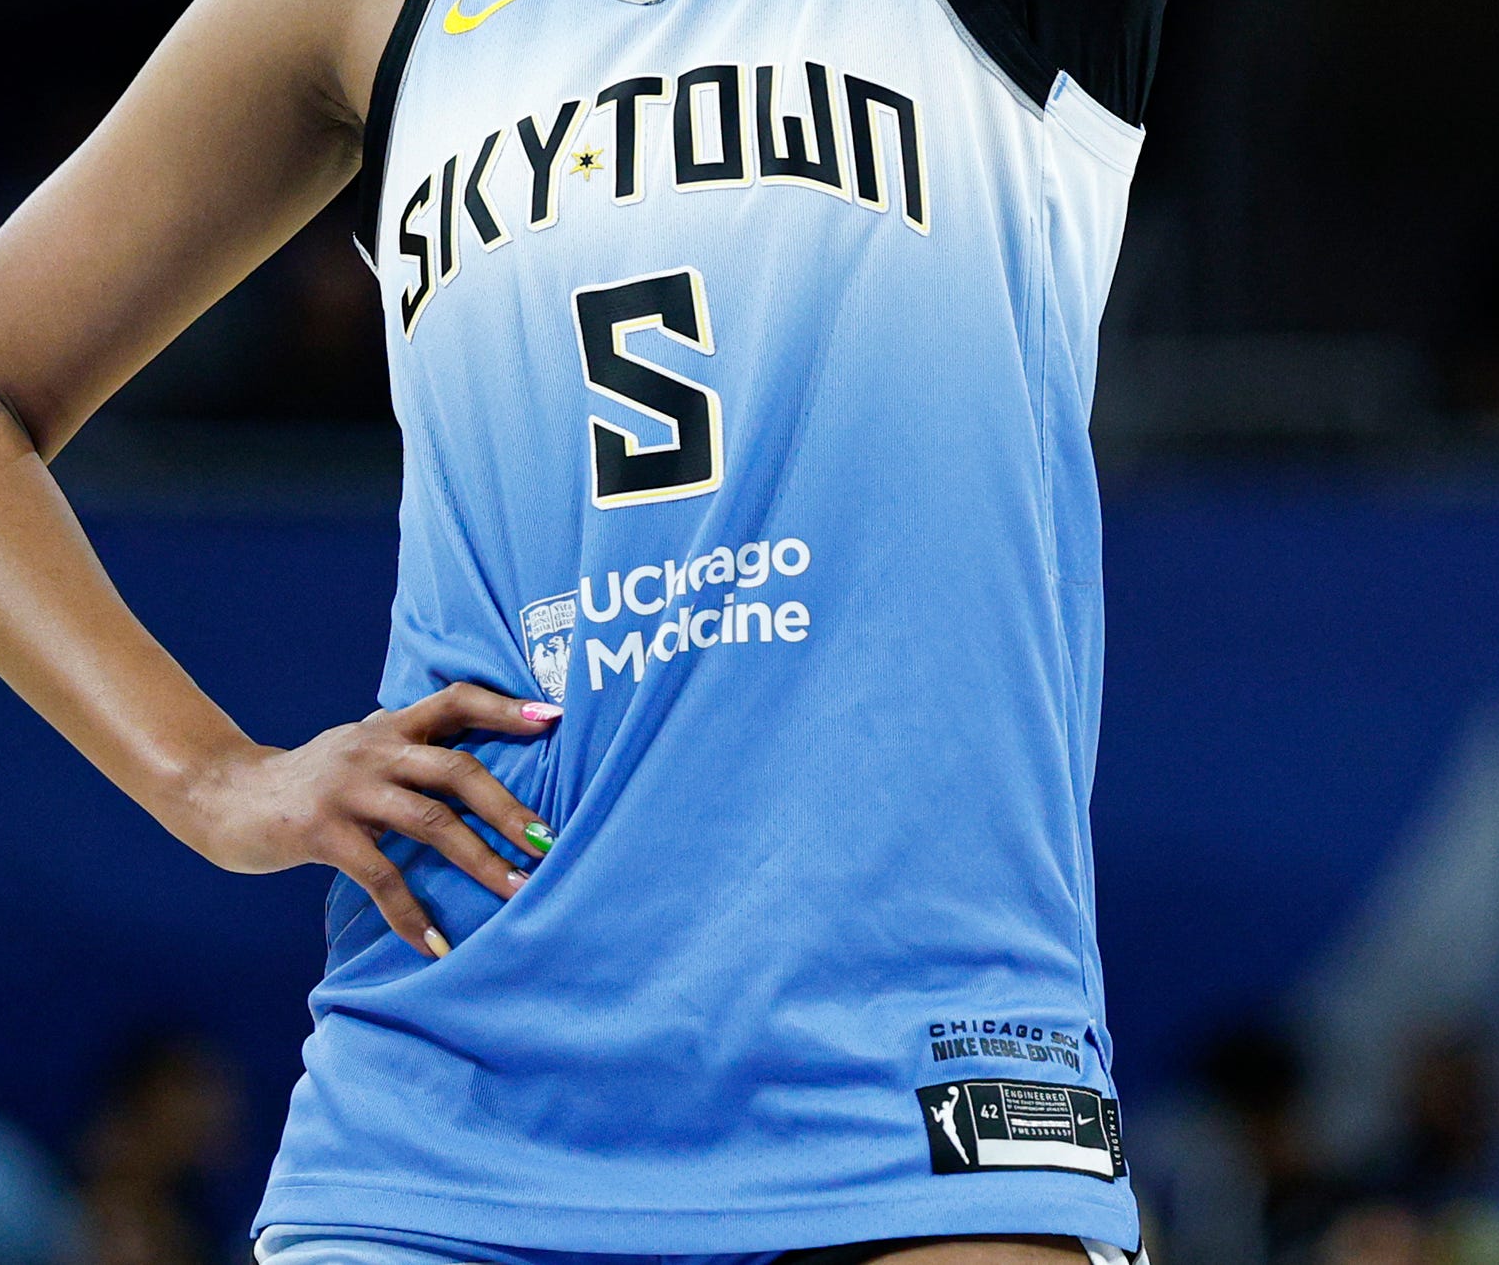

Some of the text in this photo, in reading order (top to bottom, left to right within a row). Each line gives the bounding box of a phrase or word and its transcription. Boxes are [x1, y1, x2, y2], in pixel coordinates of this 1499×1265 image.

[585, 600, 811, 691] Mdcine
[929, 1020, 1043, 1042] CHICAGO
[931, 1037, 1081, 1075] NIKE REBEL EDITION
[1004, 1089, 1066, 1101] ENGINEERED
[980, 1104, 999, 1120] 42
